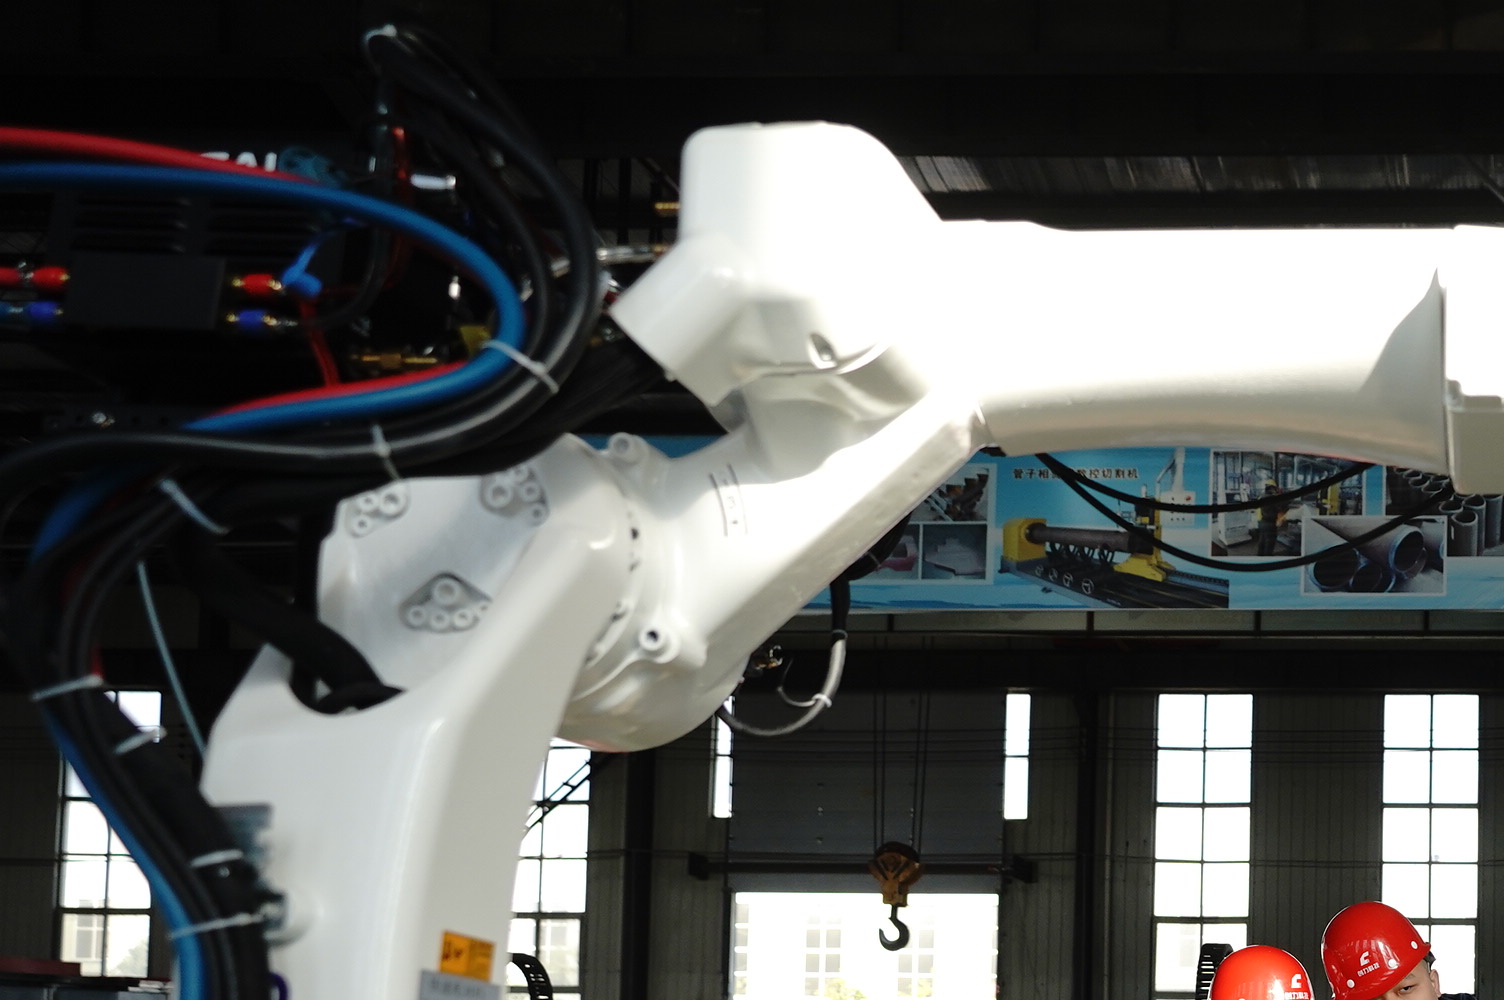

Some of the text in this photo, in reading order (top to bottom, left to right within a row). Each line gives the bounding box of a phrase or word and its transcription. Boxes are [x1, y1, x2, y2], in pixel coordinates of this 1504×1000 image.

[1013, 468, 1138, 480] 管子相数控切割机
